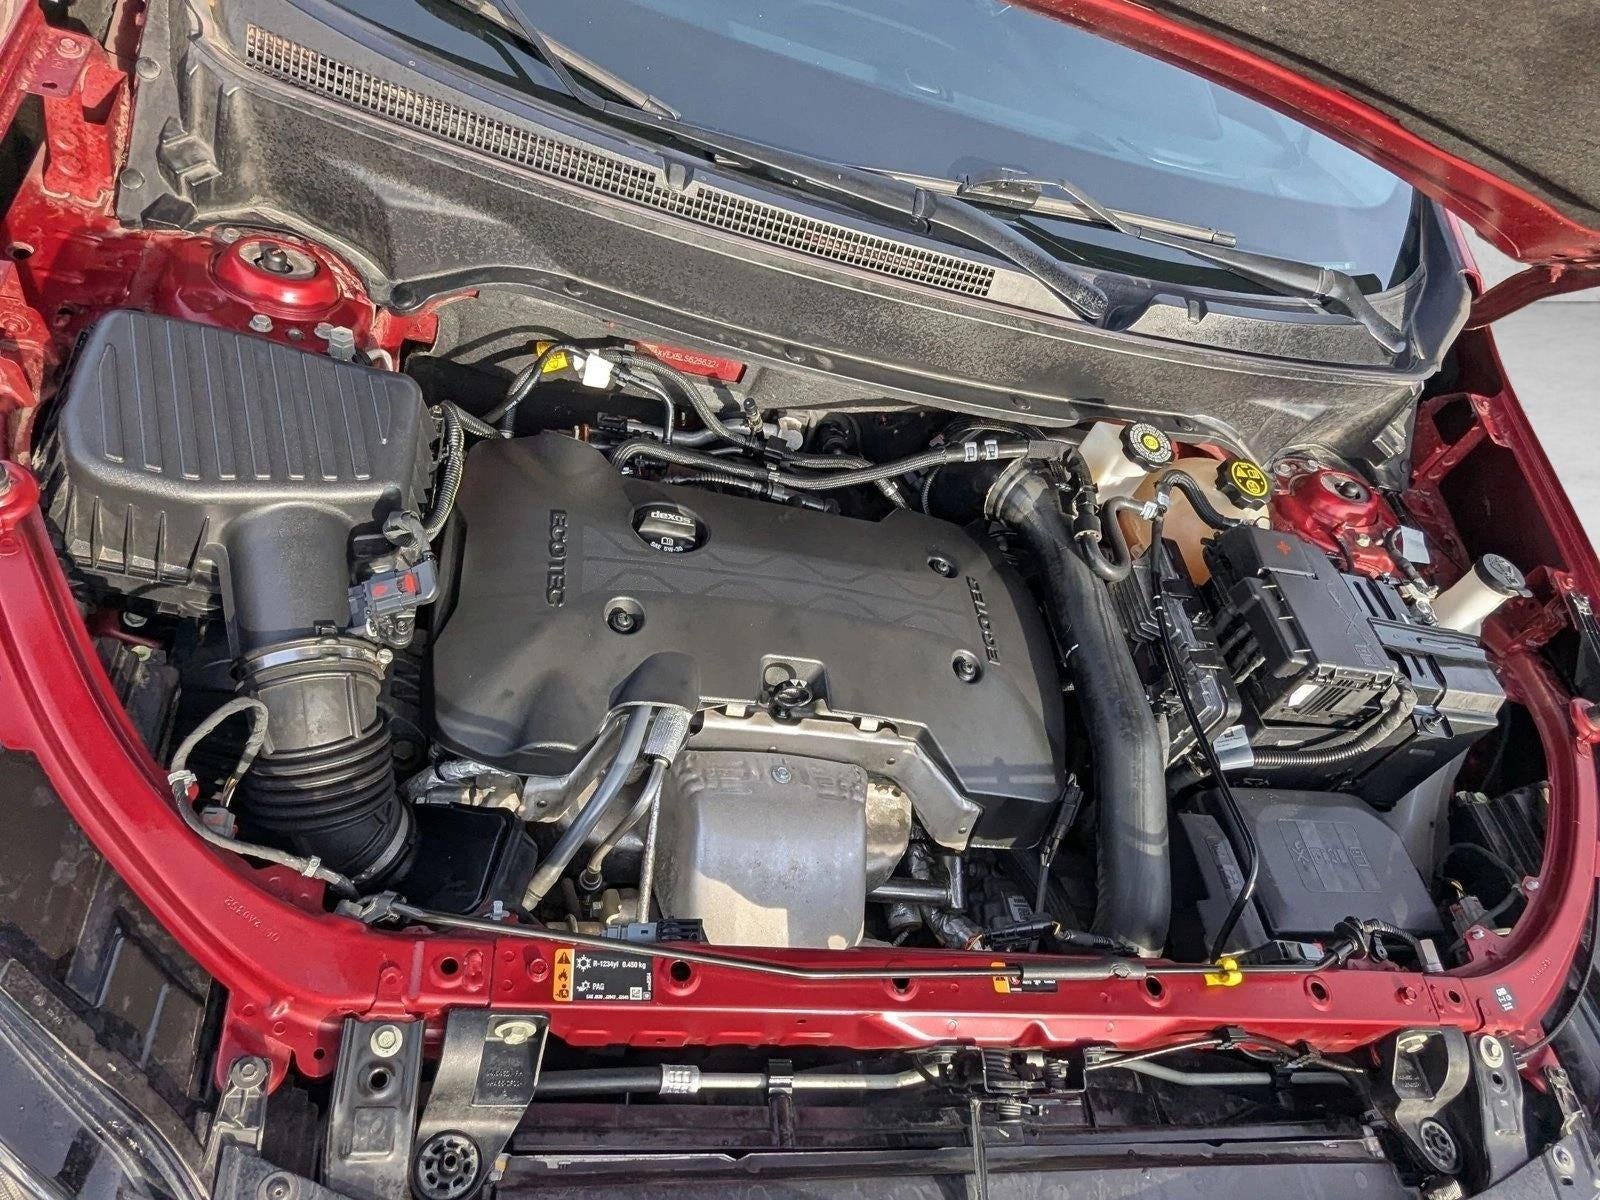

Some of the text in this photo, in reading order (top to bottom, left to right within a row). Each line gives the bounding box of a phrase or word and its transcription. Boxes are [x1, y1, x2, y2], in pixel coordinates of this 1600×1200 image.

[650, 510, 692, 524] dexos
[546, 509, 568, 607] ECOTEC
[638, 961, 647, 970] kg
